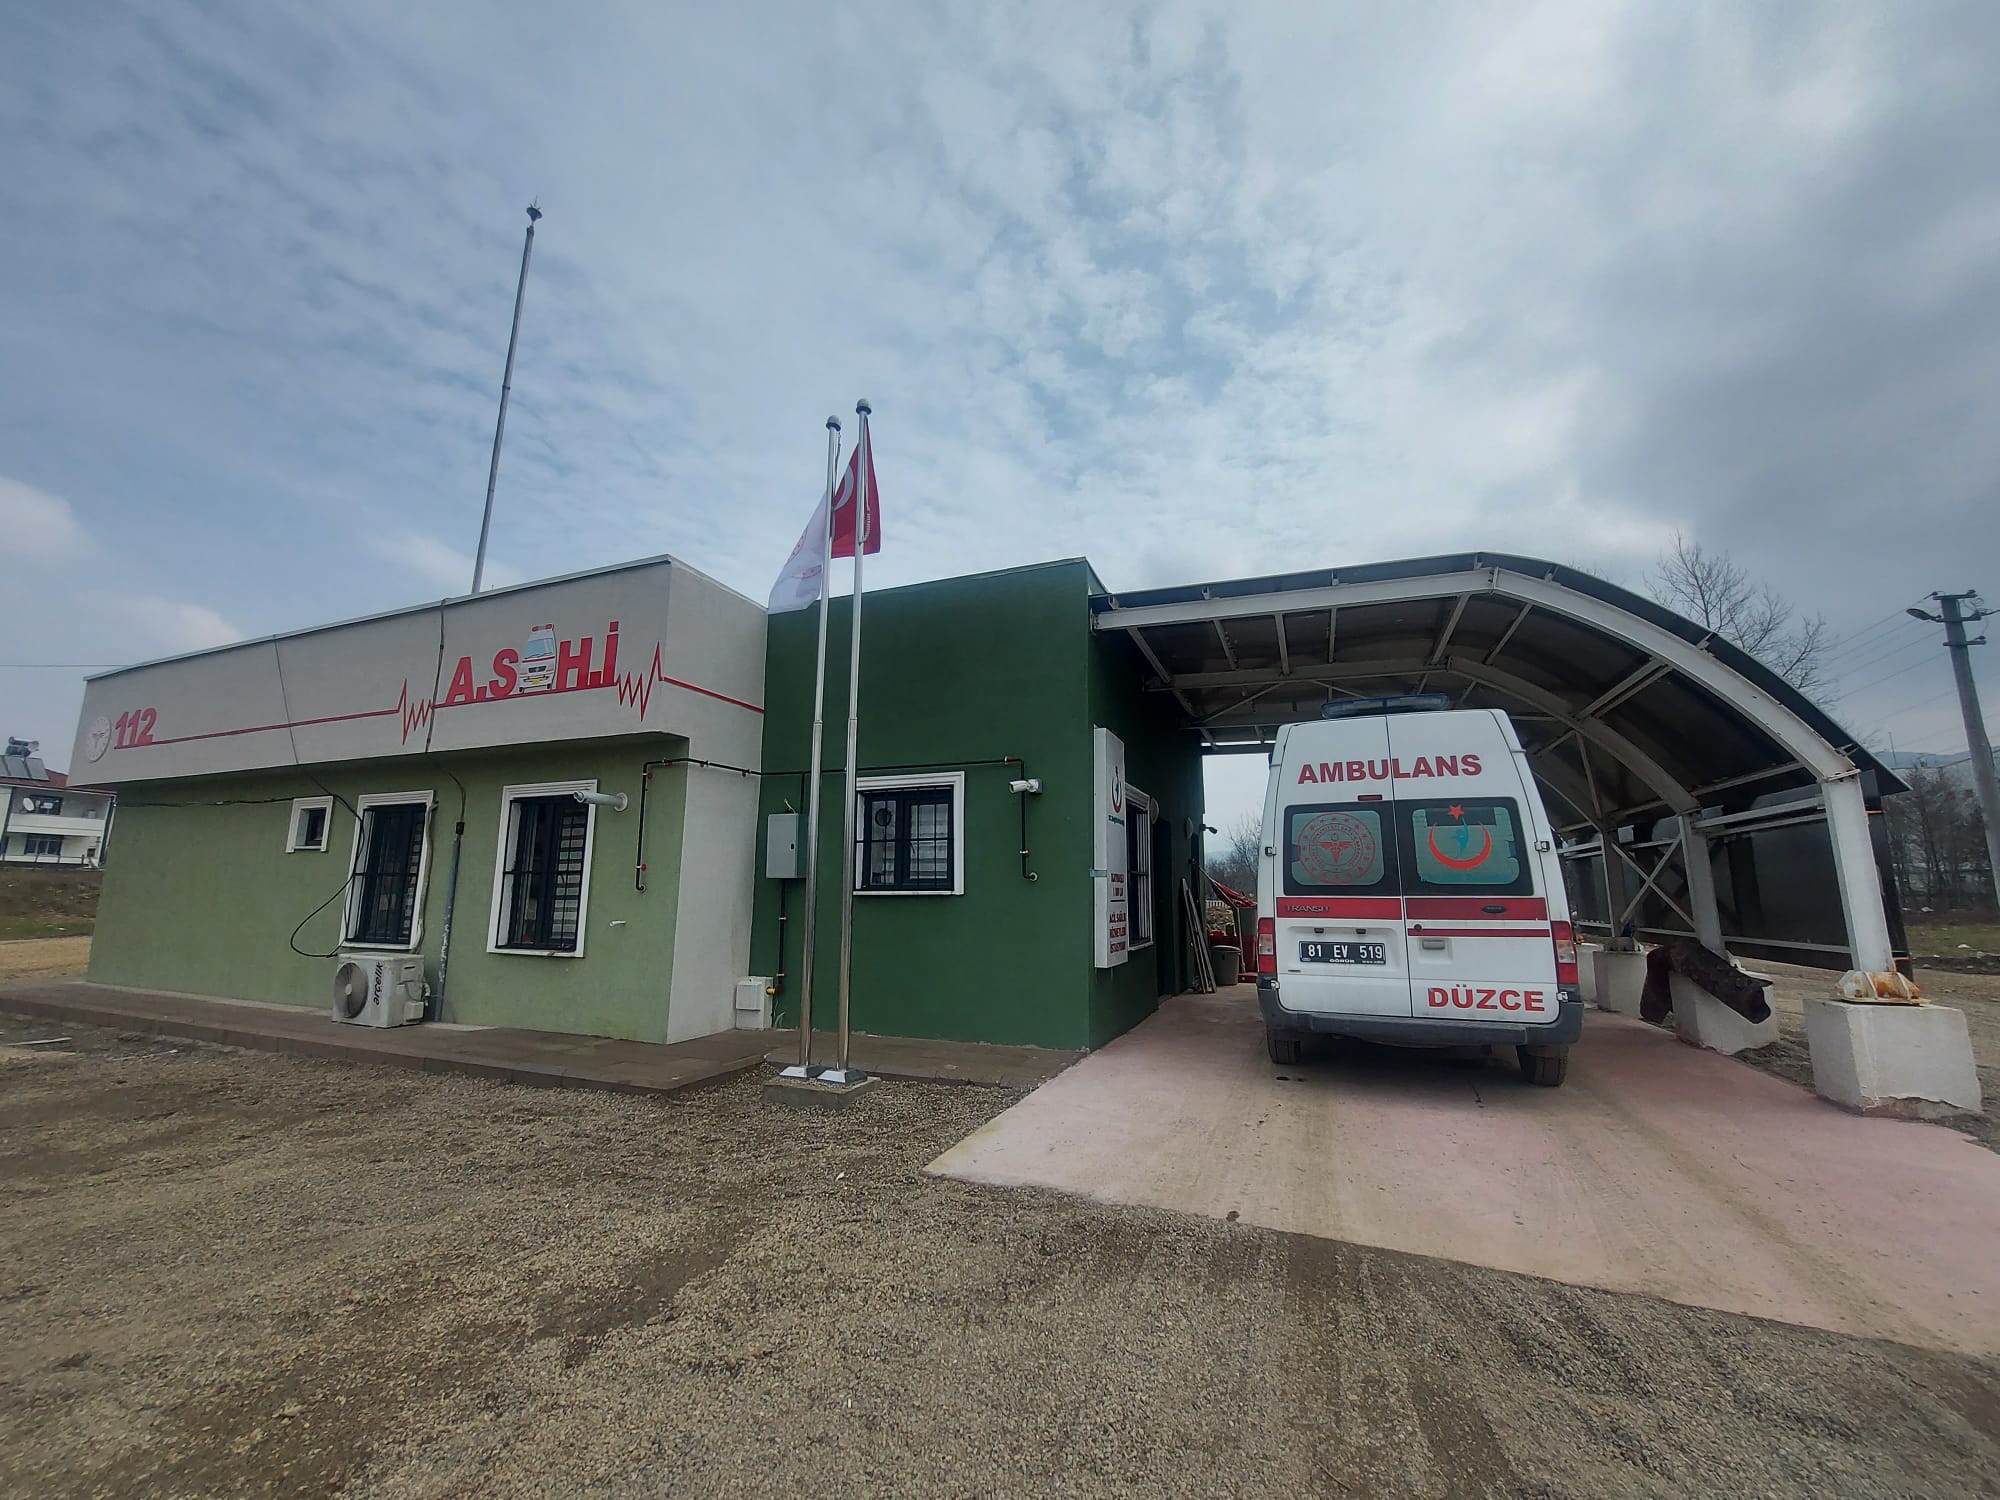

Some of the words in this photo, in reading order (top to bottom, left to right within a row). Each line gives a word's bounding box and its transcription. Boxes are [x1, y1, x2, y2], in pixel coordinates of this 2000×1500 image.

[114, 707, 157, 749] 112
[1297, 754, 1482, 784] AMBULANS
[1308, 944, 1322, 957] 81
[1333, 945, 1348, 958] EV
[1360, 945, 1383, 959] 519
[373, 961, 384, 1006] arçelik
[1427, 983, 1545, 1012] DÜZCE
